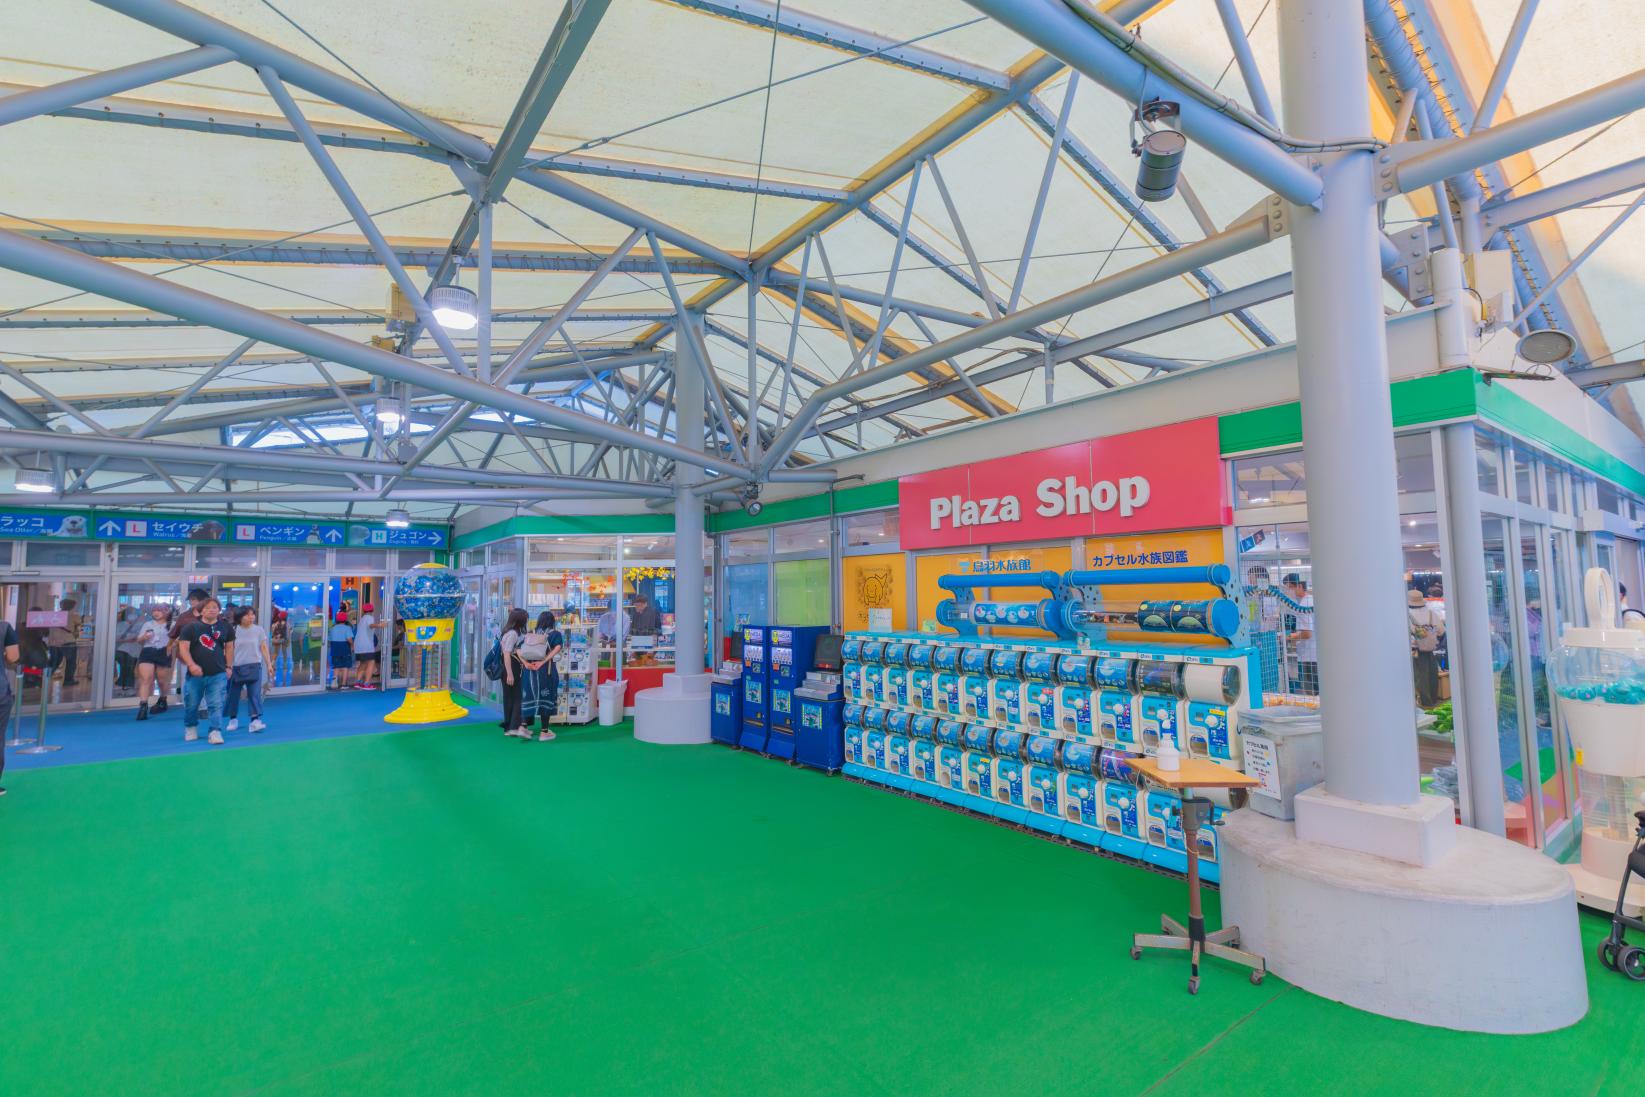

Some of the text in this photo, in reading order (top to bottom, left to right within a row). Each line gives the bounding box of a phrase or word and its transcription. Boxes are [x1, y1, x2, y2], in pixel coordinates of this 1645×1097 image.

[930, 475, 1151, 529] Plaza Shop
[0, 516, 44, 527] ラッコ
[152, 521, 204, 533] セイウチ
[242, 527, 250, 537] L
[260, 526, 305, 536] ペンギン
[375, 532, 383, 540] H
[389, 530, 427, 539] ジュゴン
[1093, 550, 1188, 567] カプセル水族図鑑
